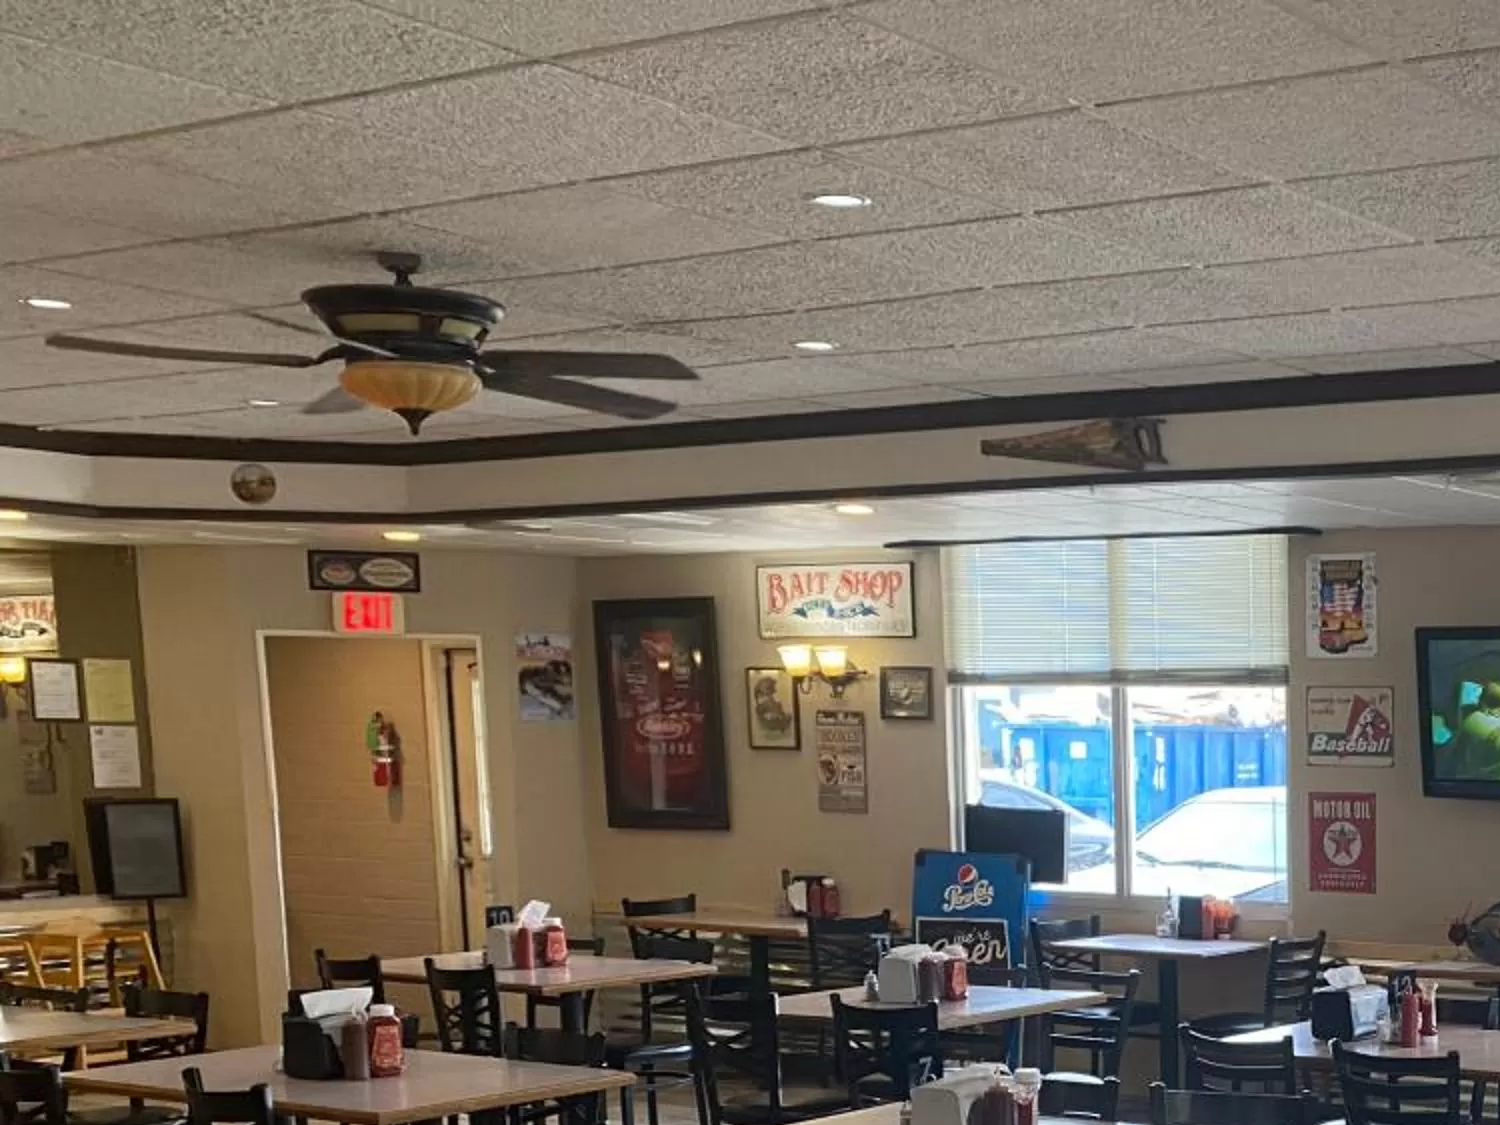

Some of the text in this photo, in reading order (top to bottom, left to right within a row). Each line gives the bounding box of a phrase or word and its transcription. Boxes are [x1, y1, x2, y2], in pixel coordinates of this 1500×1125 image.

[767, 571, 830, 615] BAIT
[833, 568, 904, 609] SHOP
[344, 593, 393, 631] EXIT
[1311, 733, 1391, 753] Baseball
[1312, 799, 1371, 819] MOTOR OIL
